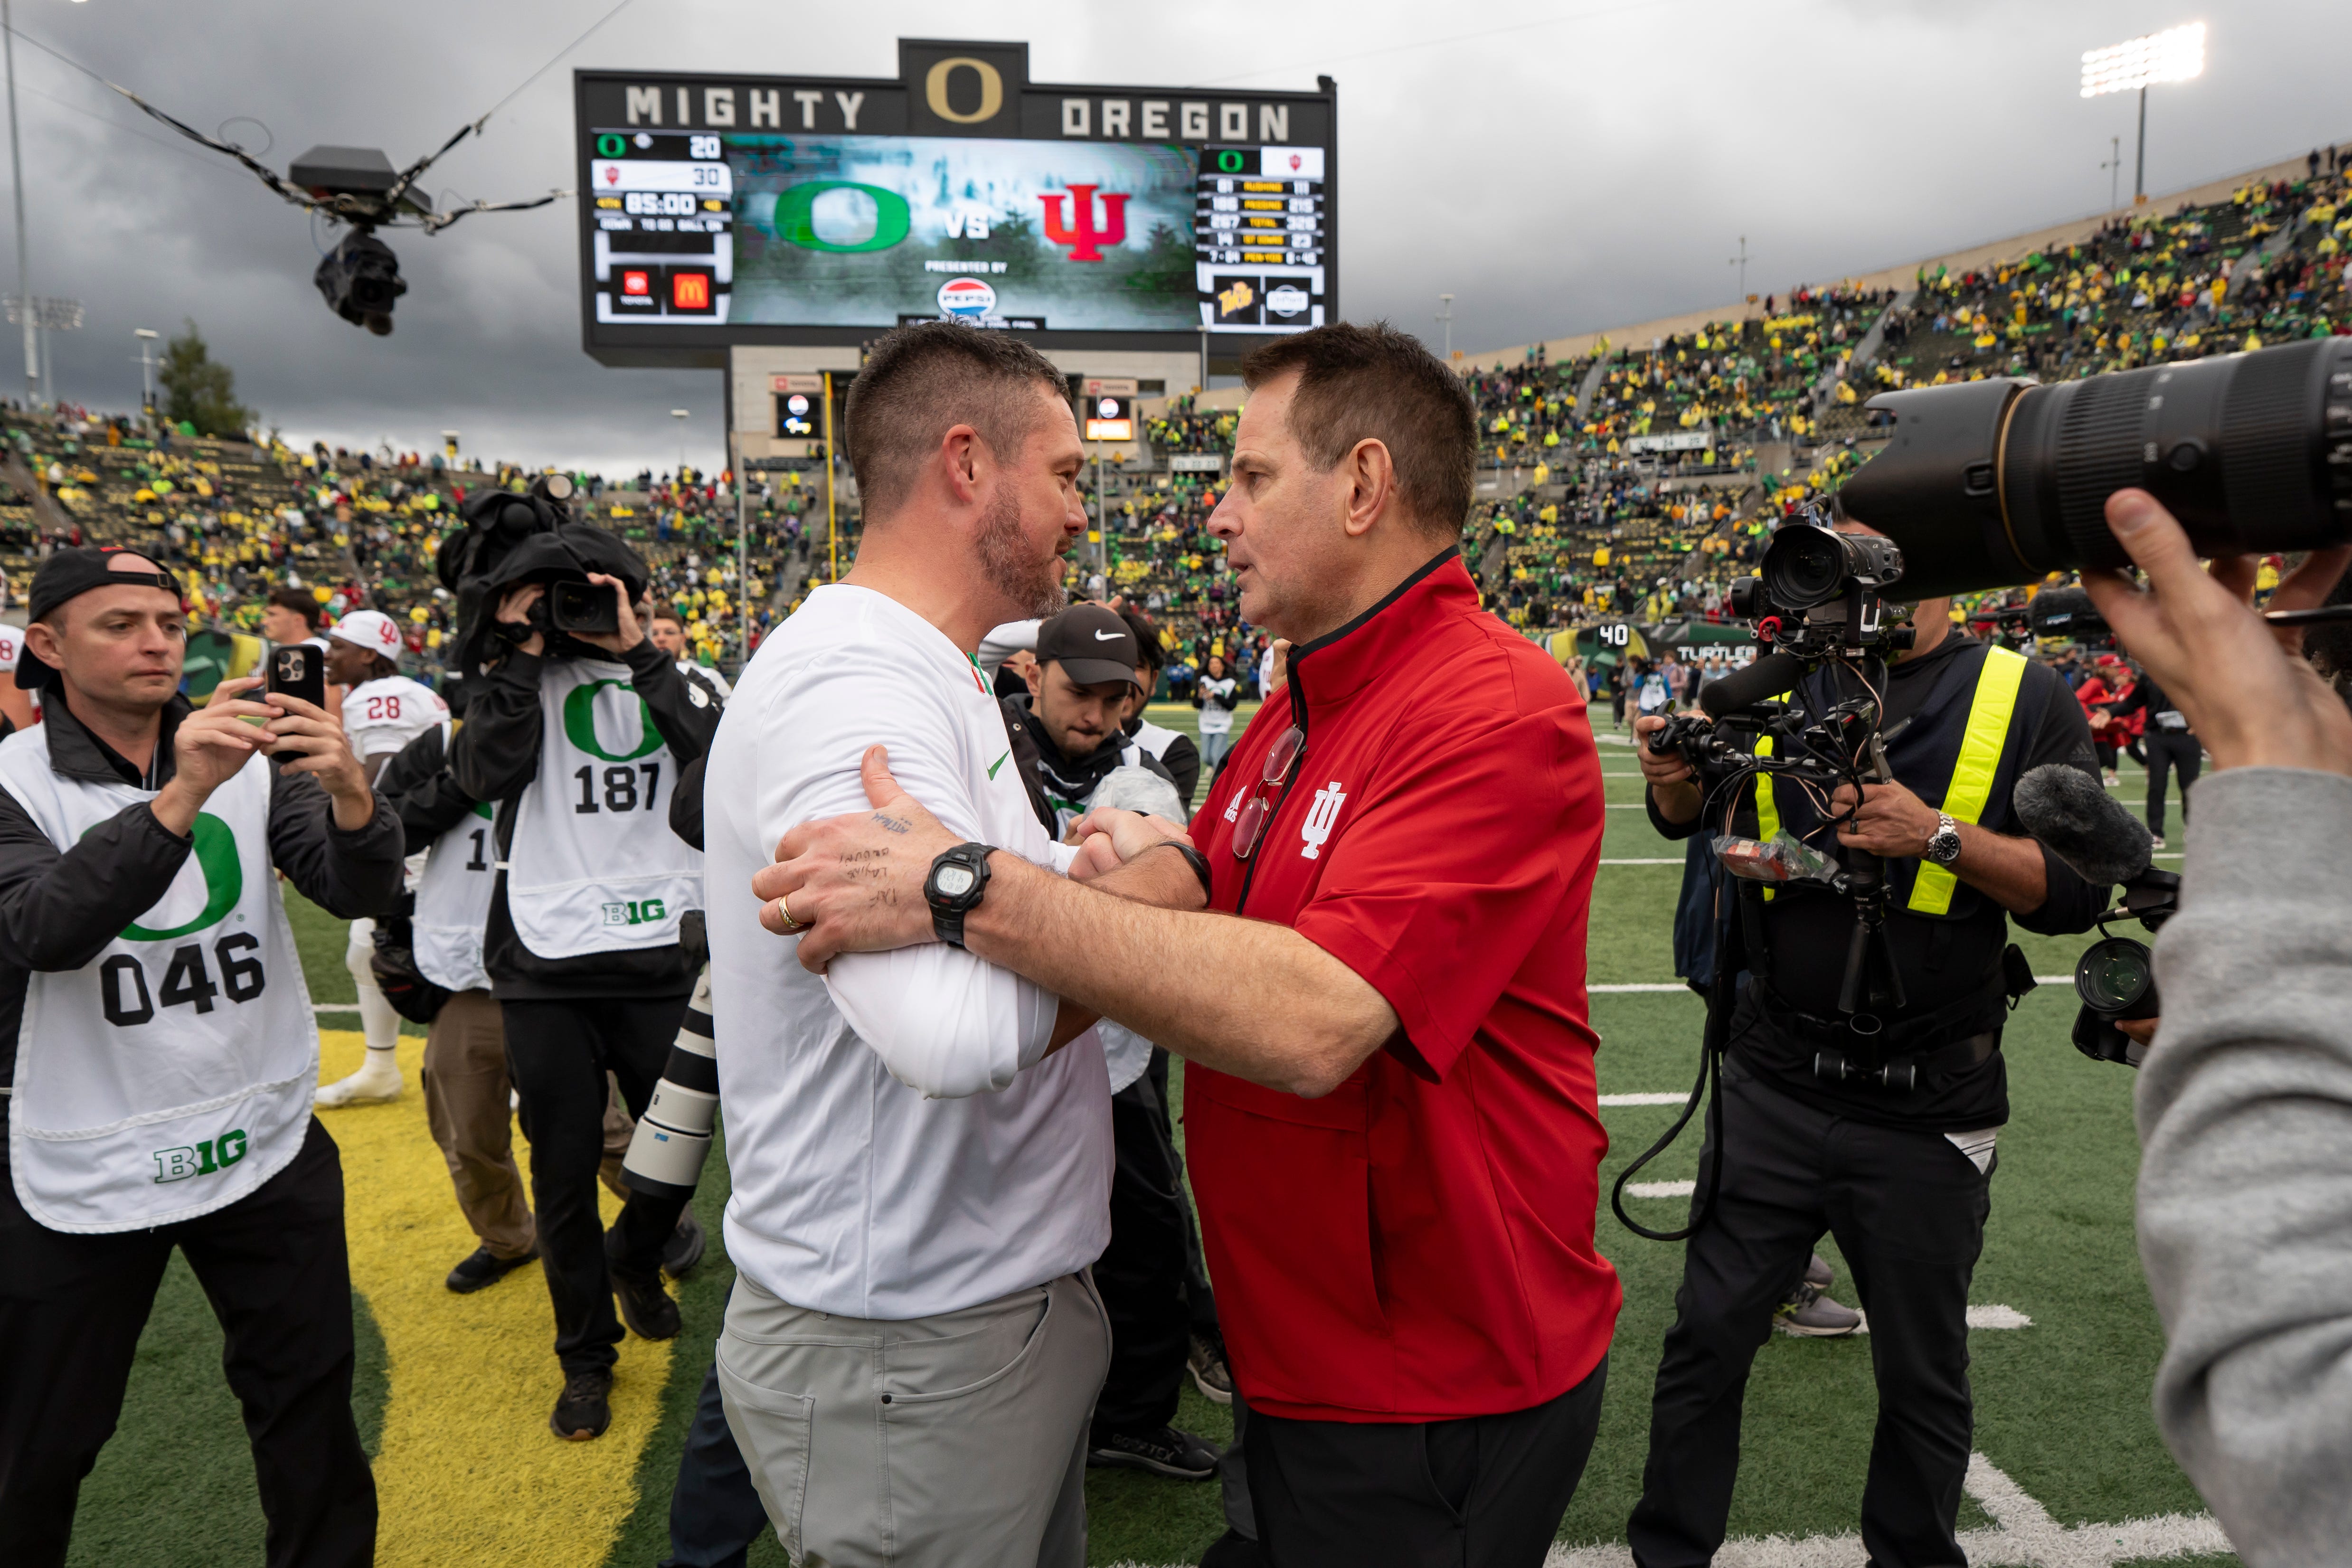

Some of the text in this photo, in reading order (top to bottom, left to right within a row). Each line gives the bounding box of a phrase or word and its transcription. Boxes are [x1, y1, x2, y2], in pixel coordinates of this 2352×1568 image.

[926, 57, 1003, 124] O
[625, 86, 865, 130] MIGHTY
[1062, 98, 1289, 142] OREGON
[690, 135, 721, 159] 20
[694, 168, 718, 185] 30
[943, 209, 990, 239] VS
[925, 260, 1008, 274] PRESENTED BY
[1599, 624, 1629, 646] 40
[367, 696, 400, 719] 28
[575, 762, 660, 815] 187
[100, 931, 265, 1027] 046
